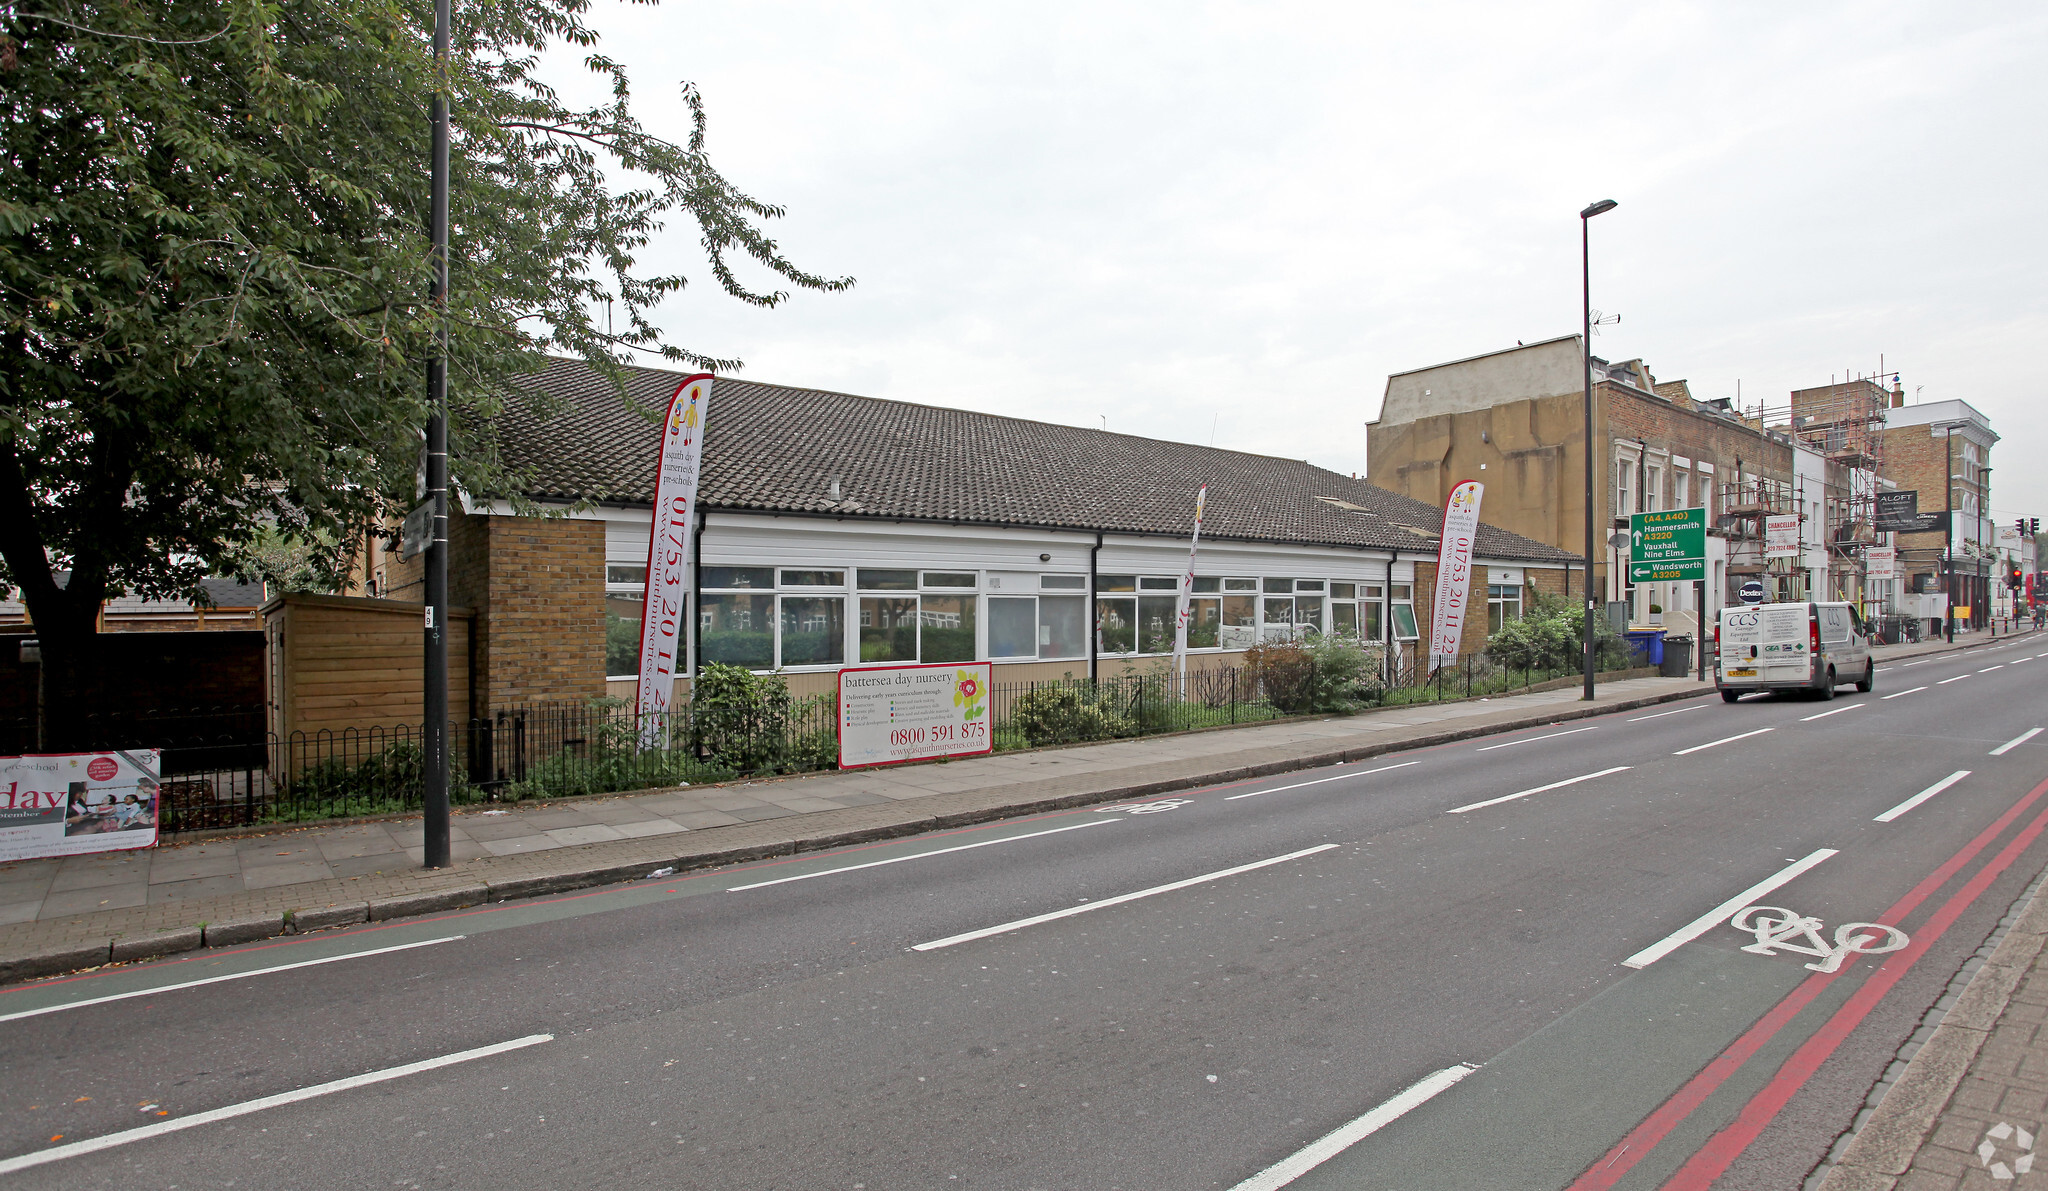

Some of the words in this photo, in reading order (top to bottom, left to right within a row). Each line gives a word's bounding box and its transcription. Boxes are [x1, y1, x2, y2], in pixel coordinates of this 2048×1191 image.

[1880, 494, 1913, 503] ALOFT
[1665, 512, 1688, 521] A40)
[1644, 521, 1700, 532] Hammersmith
[1768, 521, 1796, 529] CHANCELLOR
[664, 496, 687, 586] 01753
[1644, 532, 1673, 541] A3220
[1643, 541, 1678, 550] Vauxhall
[1453, 537, 1469, 582] 01753
[1651, 561, 1702, 571] Wandsworth
[1652, 570, 1681, 579] A3205
[1448, 588, 1463, 608] 20
[642, 496, 669, 717] www.asquithnurseries.co.u
[659, 598, 678, 638] 20
[1446, 613, 1459, 628] 11
[1729, 613, 1759, 626] CCS
[1441, 635, 1456, 654] 22
[845, 675, 892, 688] battersea
[895, 672, 913, 688] day
[916, 672, 953, 685] nursery
[890, 727, 925, 747] 0800
[931, 724, 955, 742] 591
[961, 721, 985, 739] 875
[890, 738, 985, 757] www.asquithnurseries.co.uk
